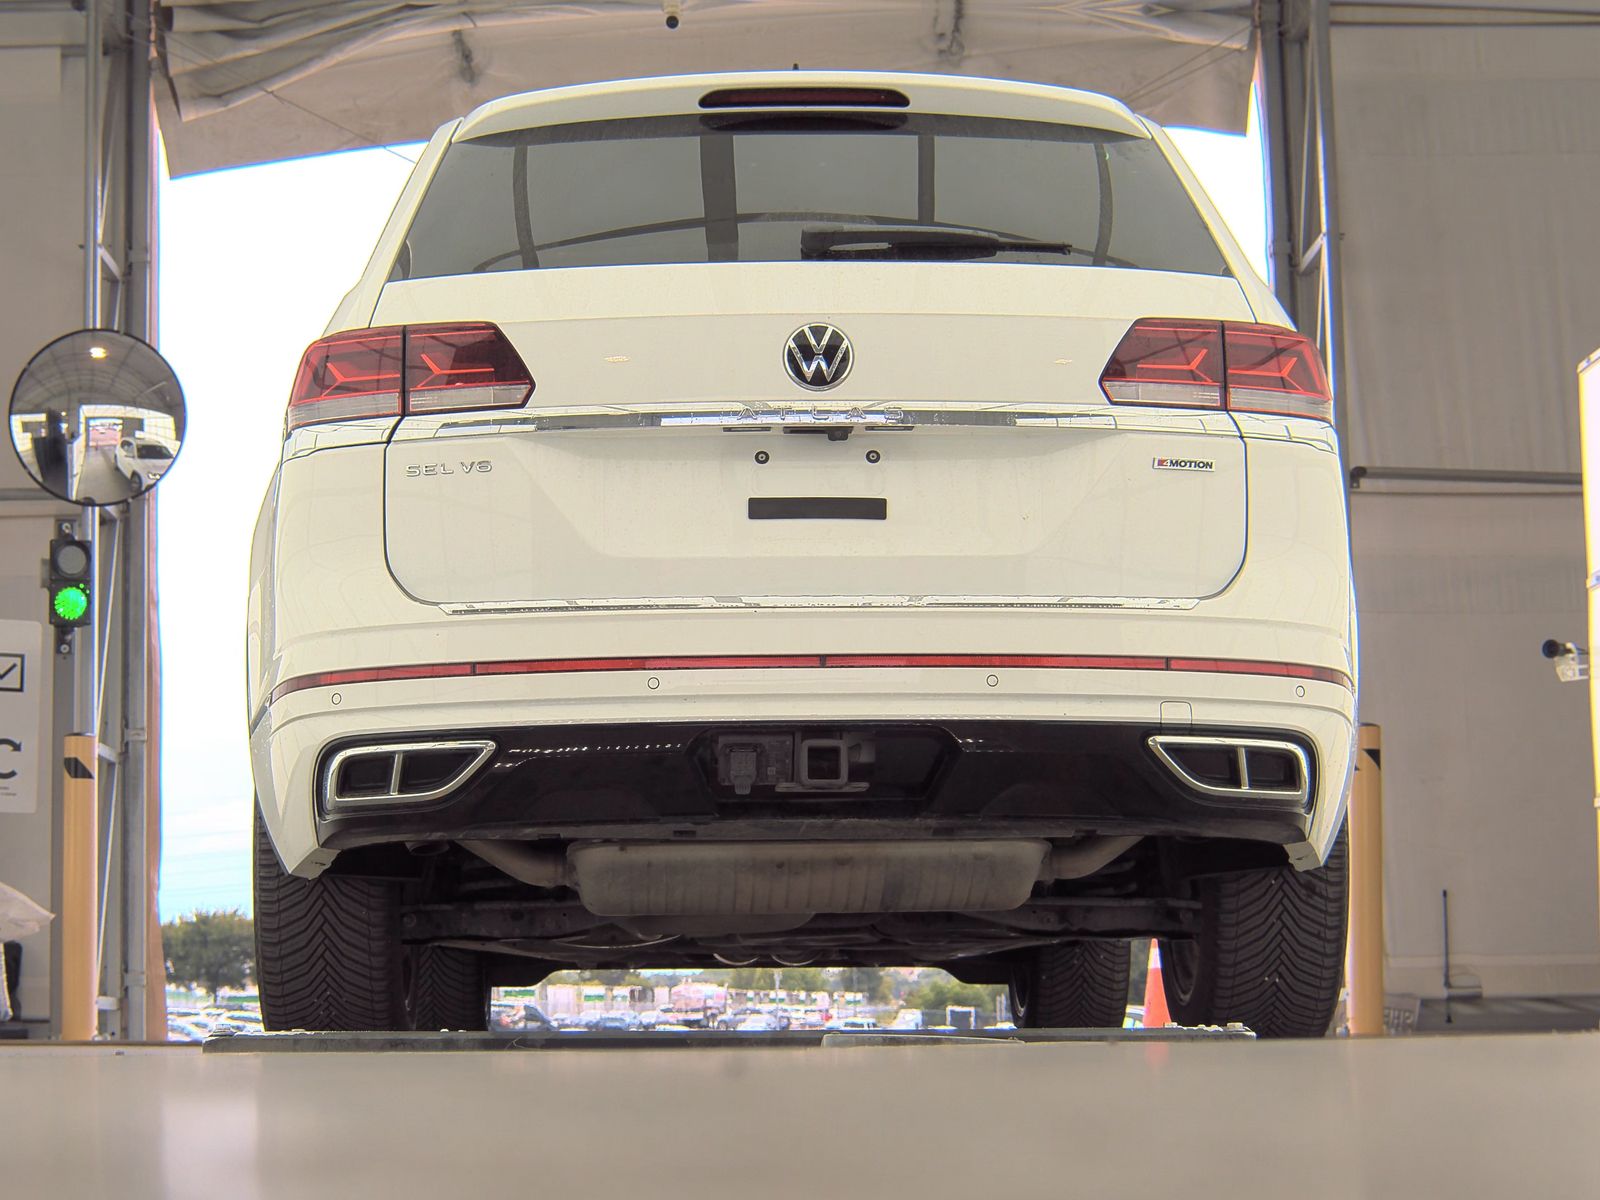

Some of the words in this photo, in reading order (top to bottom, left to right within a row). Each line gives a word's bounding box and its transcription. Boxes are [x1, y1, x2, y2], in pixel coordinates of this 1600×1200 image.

[785, 324, 851, 388] VW
[736, 406, 904, 421] ATLAS
[405, 463, 454, 477] SEL
[460, 460, 493, 474] V6
